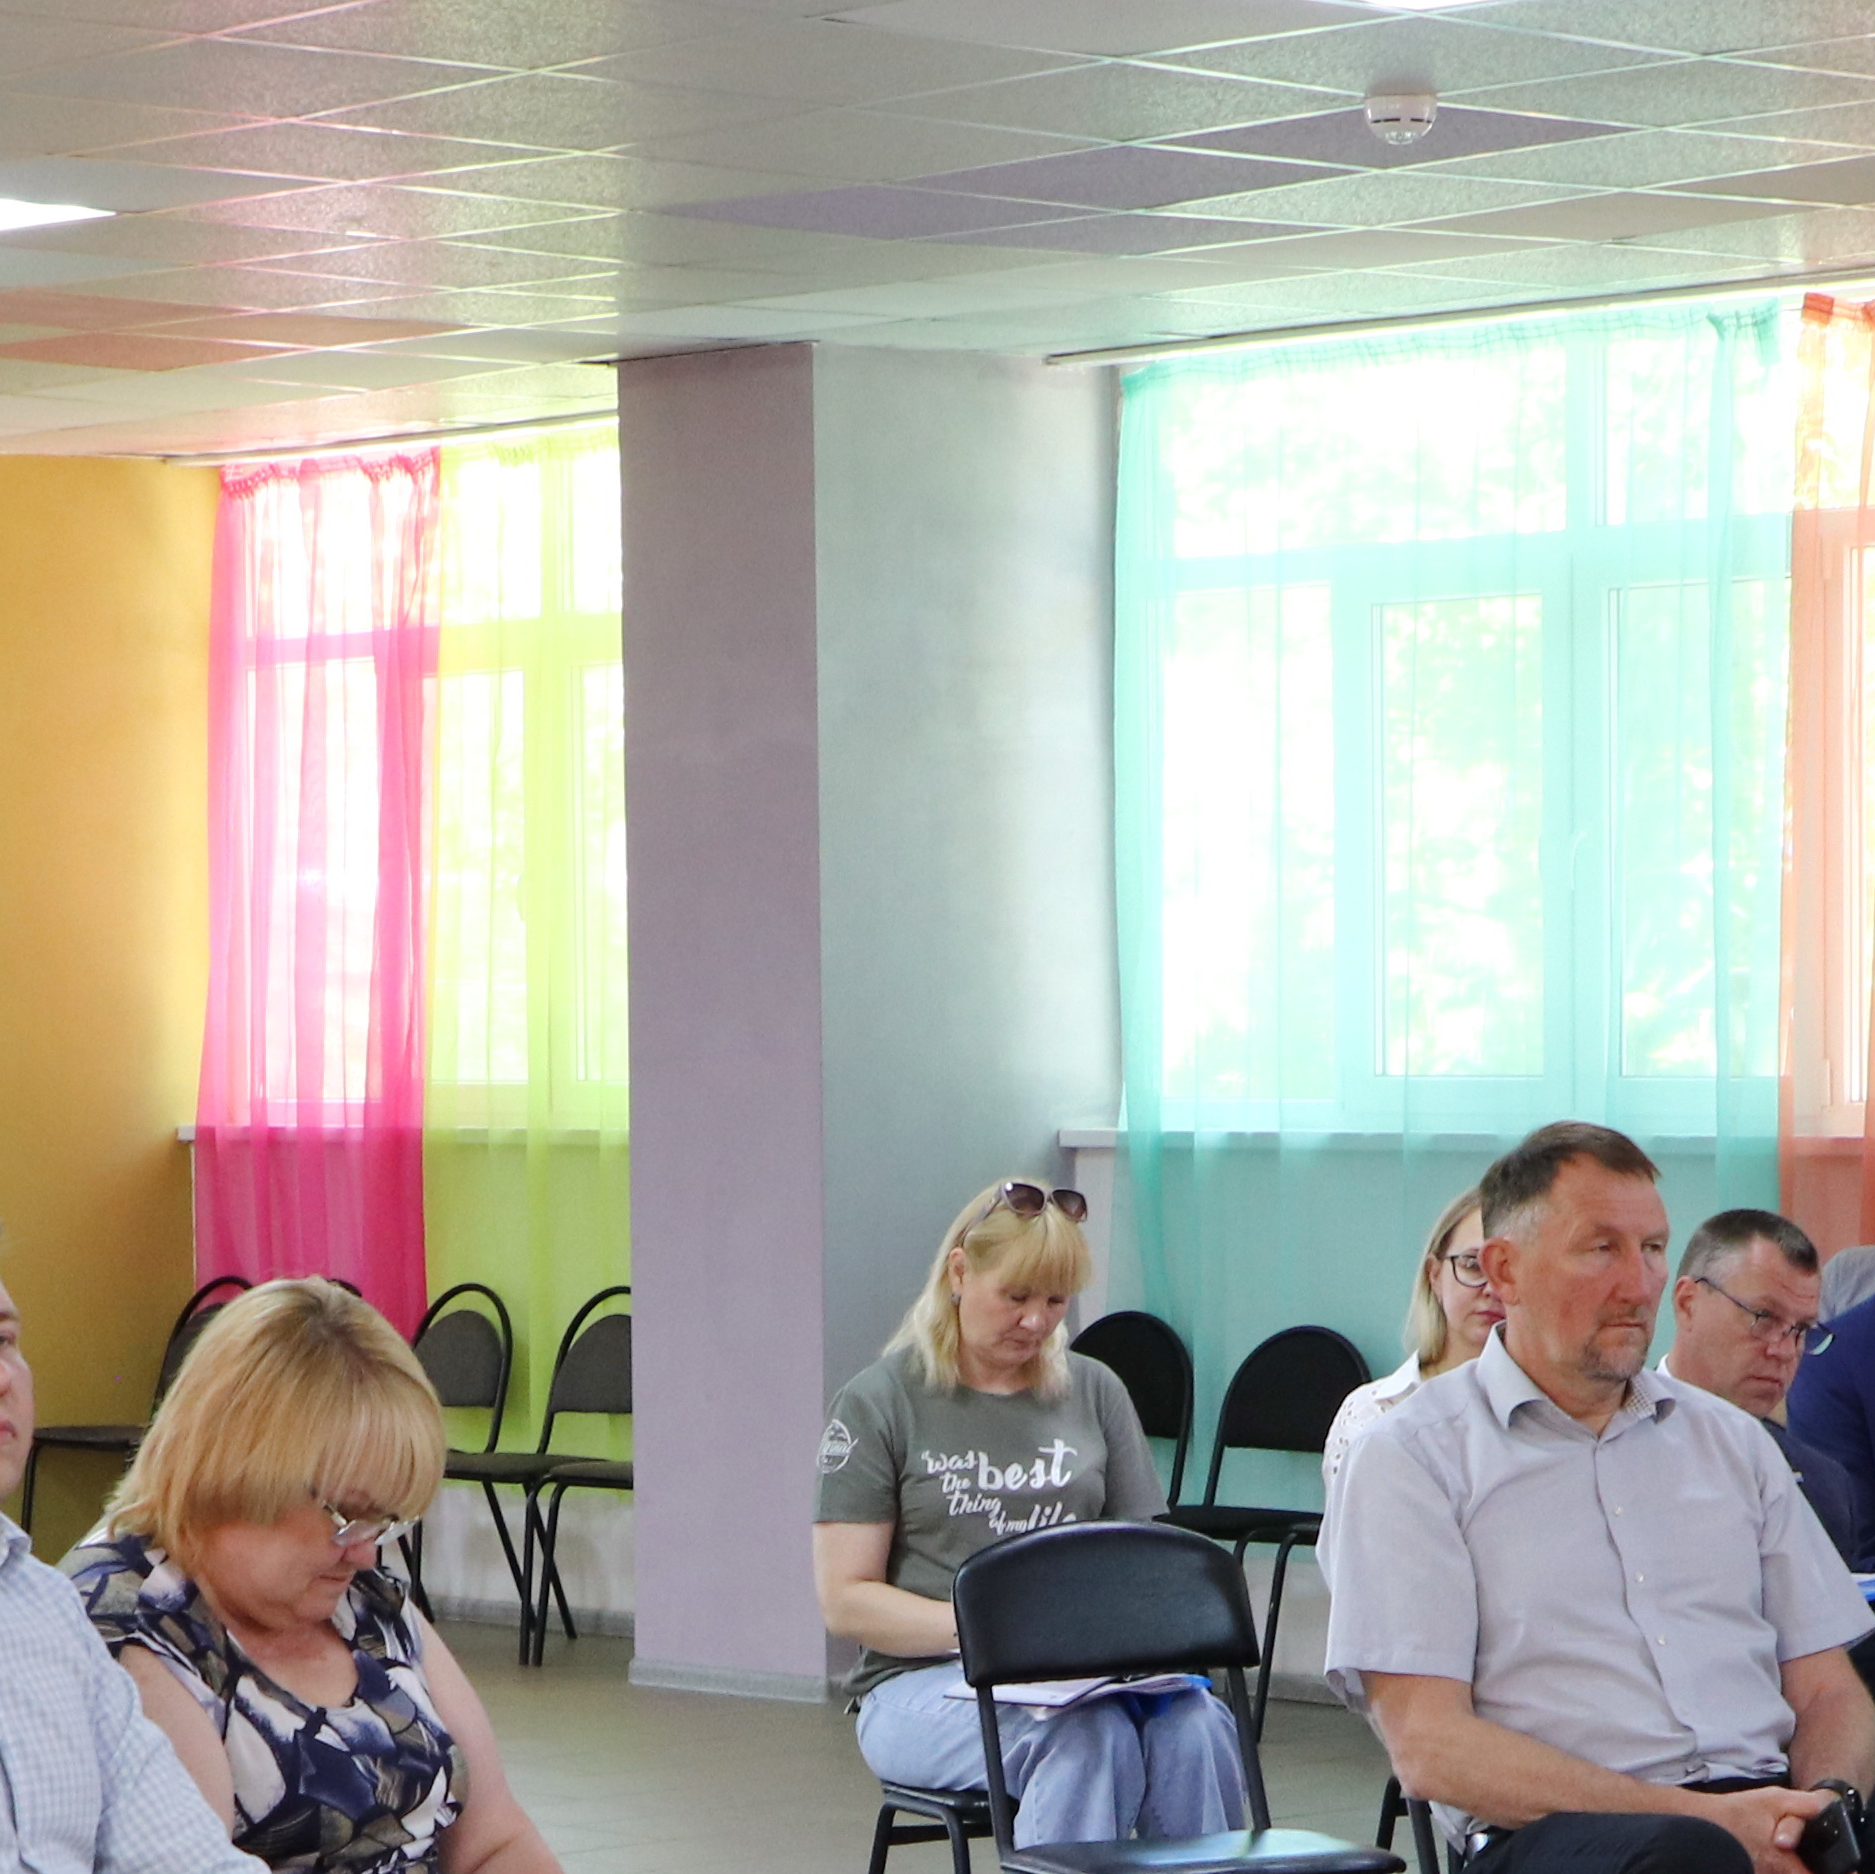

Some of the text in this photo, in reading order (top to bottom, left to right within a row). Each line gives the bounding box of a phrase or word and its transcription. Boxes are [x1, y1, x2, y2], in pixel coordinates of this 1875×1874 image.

[921, 1438, 1078, 1491] was best
[939, 1472, 971, 1493] the
[946, 1490, 1001, 1519] thing
[989, 1510, 1006, 1536] of
[1006, 1519, 1028, 1534] my
